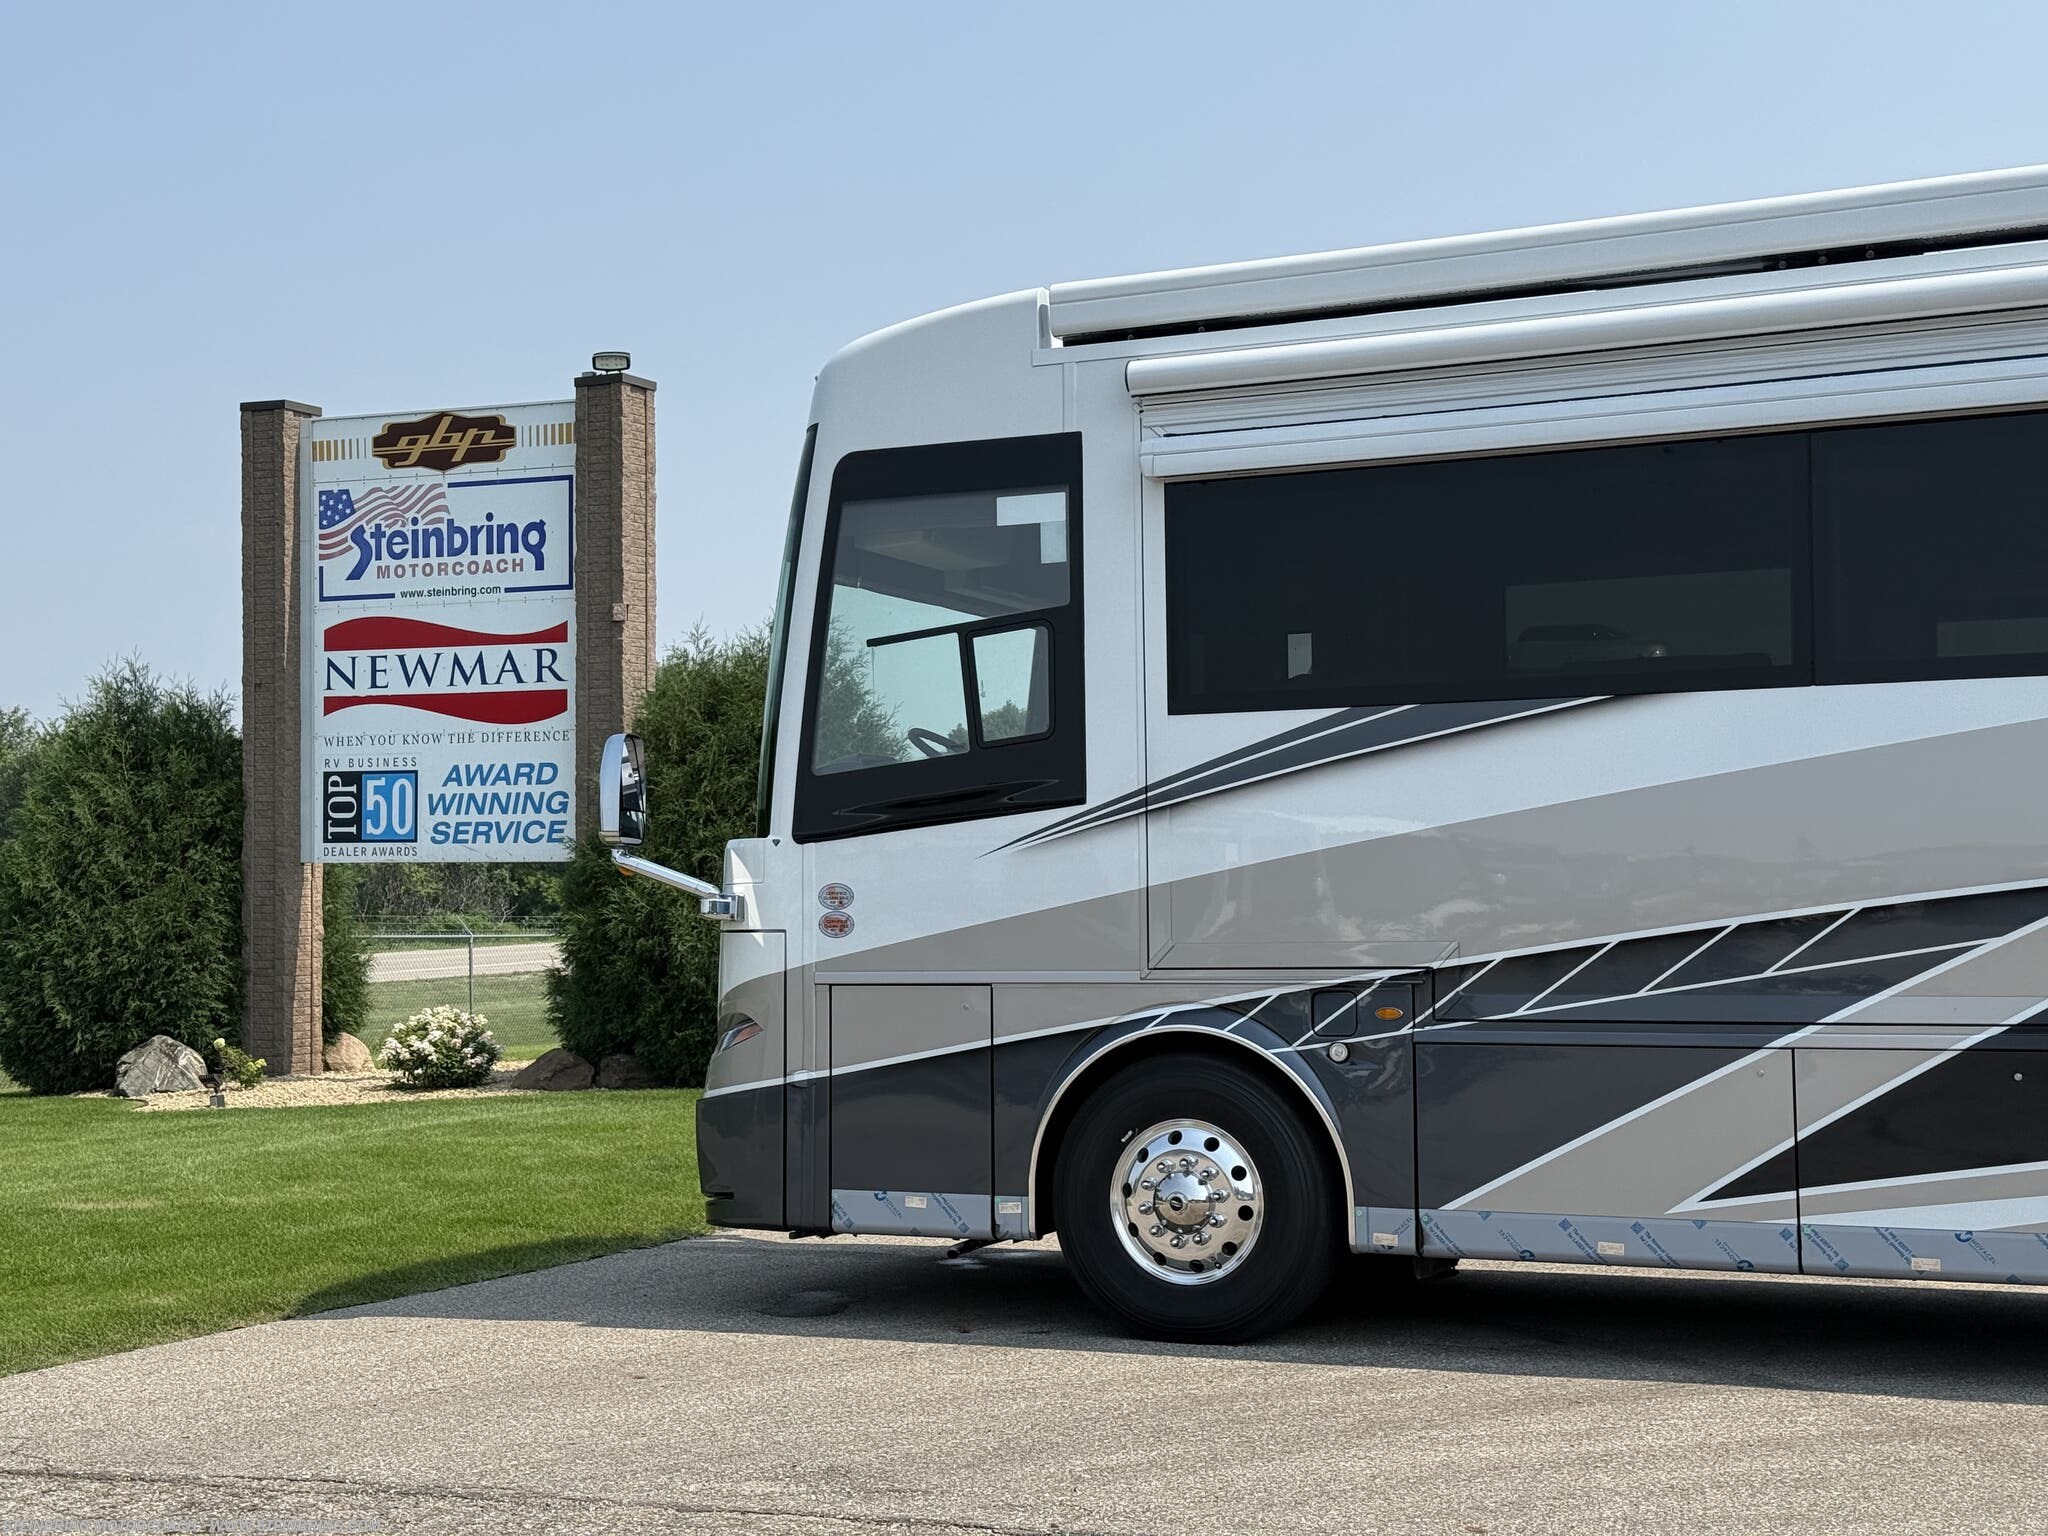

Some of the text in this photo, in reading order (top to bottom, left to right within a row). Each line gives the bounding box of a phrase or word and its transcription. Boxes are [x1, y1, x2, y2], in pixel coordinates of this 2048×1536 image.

[345, 511, 546, 581] Steinbring
[376, 558, 525, 580] MOTORCOACH
[400, 585, 502, 599] www.steinbring.com
[323, 648, 569, 691] NEWMAR
[324, 730, 570, 748] WHEN YOU KNOW THE DIFFERENCE
[324, 756, 418, 769] RV BUSINESS
[442, 762, 559, 788] AWARD
[327, 774, 415, 840] TOP 50
[427, 790, 570, 817] WINNING
[430, 819, 568, 845] SERVICE
[323, 846, 418, 858] DEALER AWARDS
